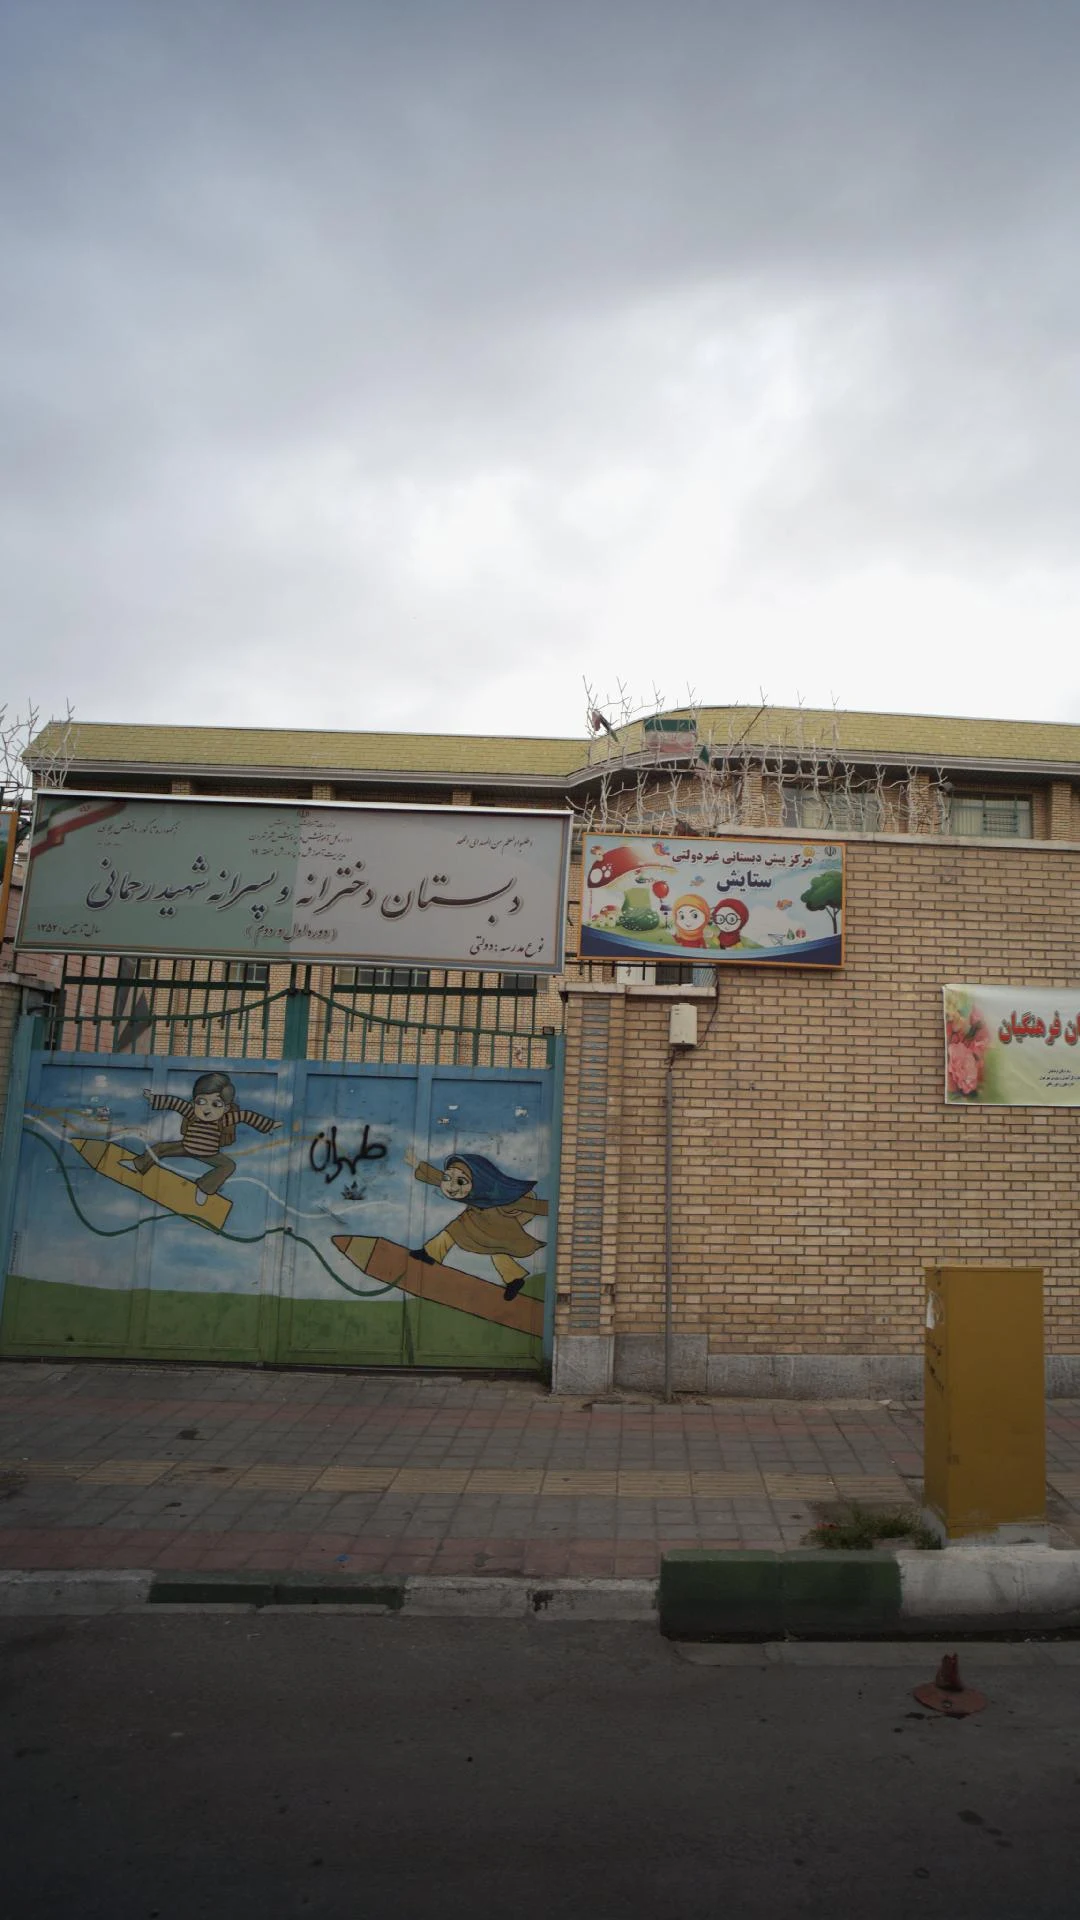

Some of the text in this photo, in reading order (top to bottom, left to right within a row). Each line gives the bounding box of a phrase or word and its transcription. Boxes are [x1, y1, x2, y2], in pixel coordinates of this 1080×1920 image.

[722, 850, 762, 865] دبستانی
[764, 852, 786, 867] پیش
[789, 852, 813, 868] مرکز
[86, 855, 523, 925] دبستان دخترانه و پسرانه شهید رحمانی
[715, 869, 773, 893] ستایش
[469, 935, 494, 956] دولتی
[524, 937, 545, 958] نوع
[998, 1009, 1063, 1047] فرهنگیان
[309, 1124, 387, 1185] طهران
